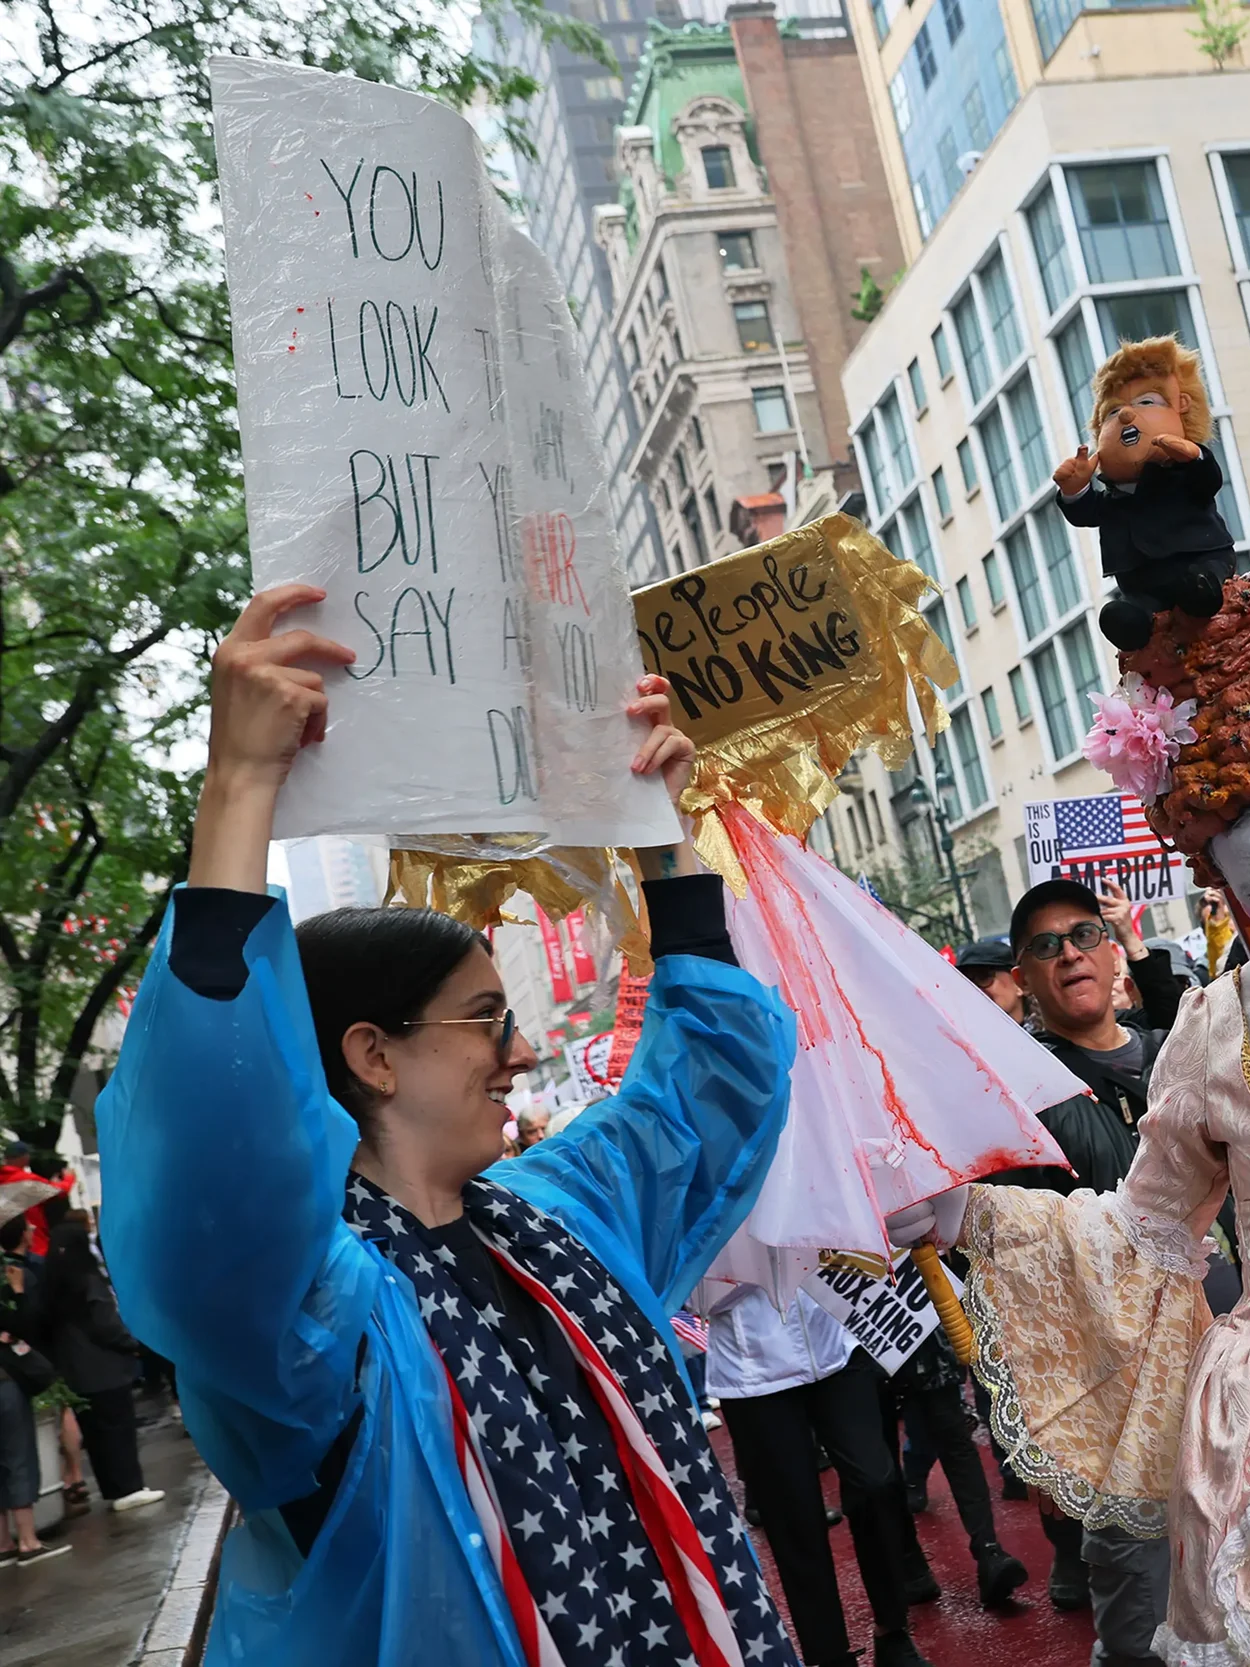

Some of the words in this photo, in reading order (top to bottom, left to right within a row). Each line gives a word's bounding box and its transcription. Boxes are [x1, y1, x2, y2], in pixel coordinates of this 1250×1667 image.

[319, 157, 444, 271] YOU
[326, 297, 451, 414] LOOK
[349, 449, 441, 574] BUT
[344, 587, 456, 685] SAY
[670, 555, 828, 653] People
[554, 621, 598, 713] YOU
[668, 655, 744, 720] NO
[737, 611, 862, 705] KING
[1026, 804, 1051, 821] THIS
[1028, 822, 1041, 839] IS
[1030, 837, 1065, 865] OUR
[843, 1308, 894, 1360] WAAAY
